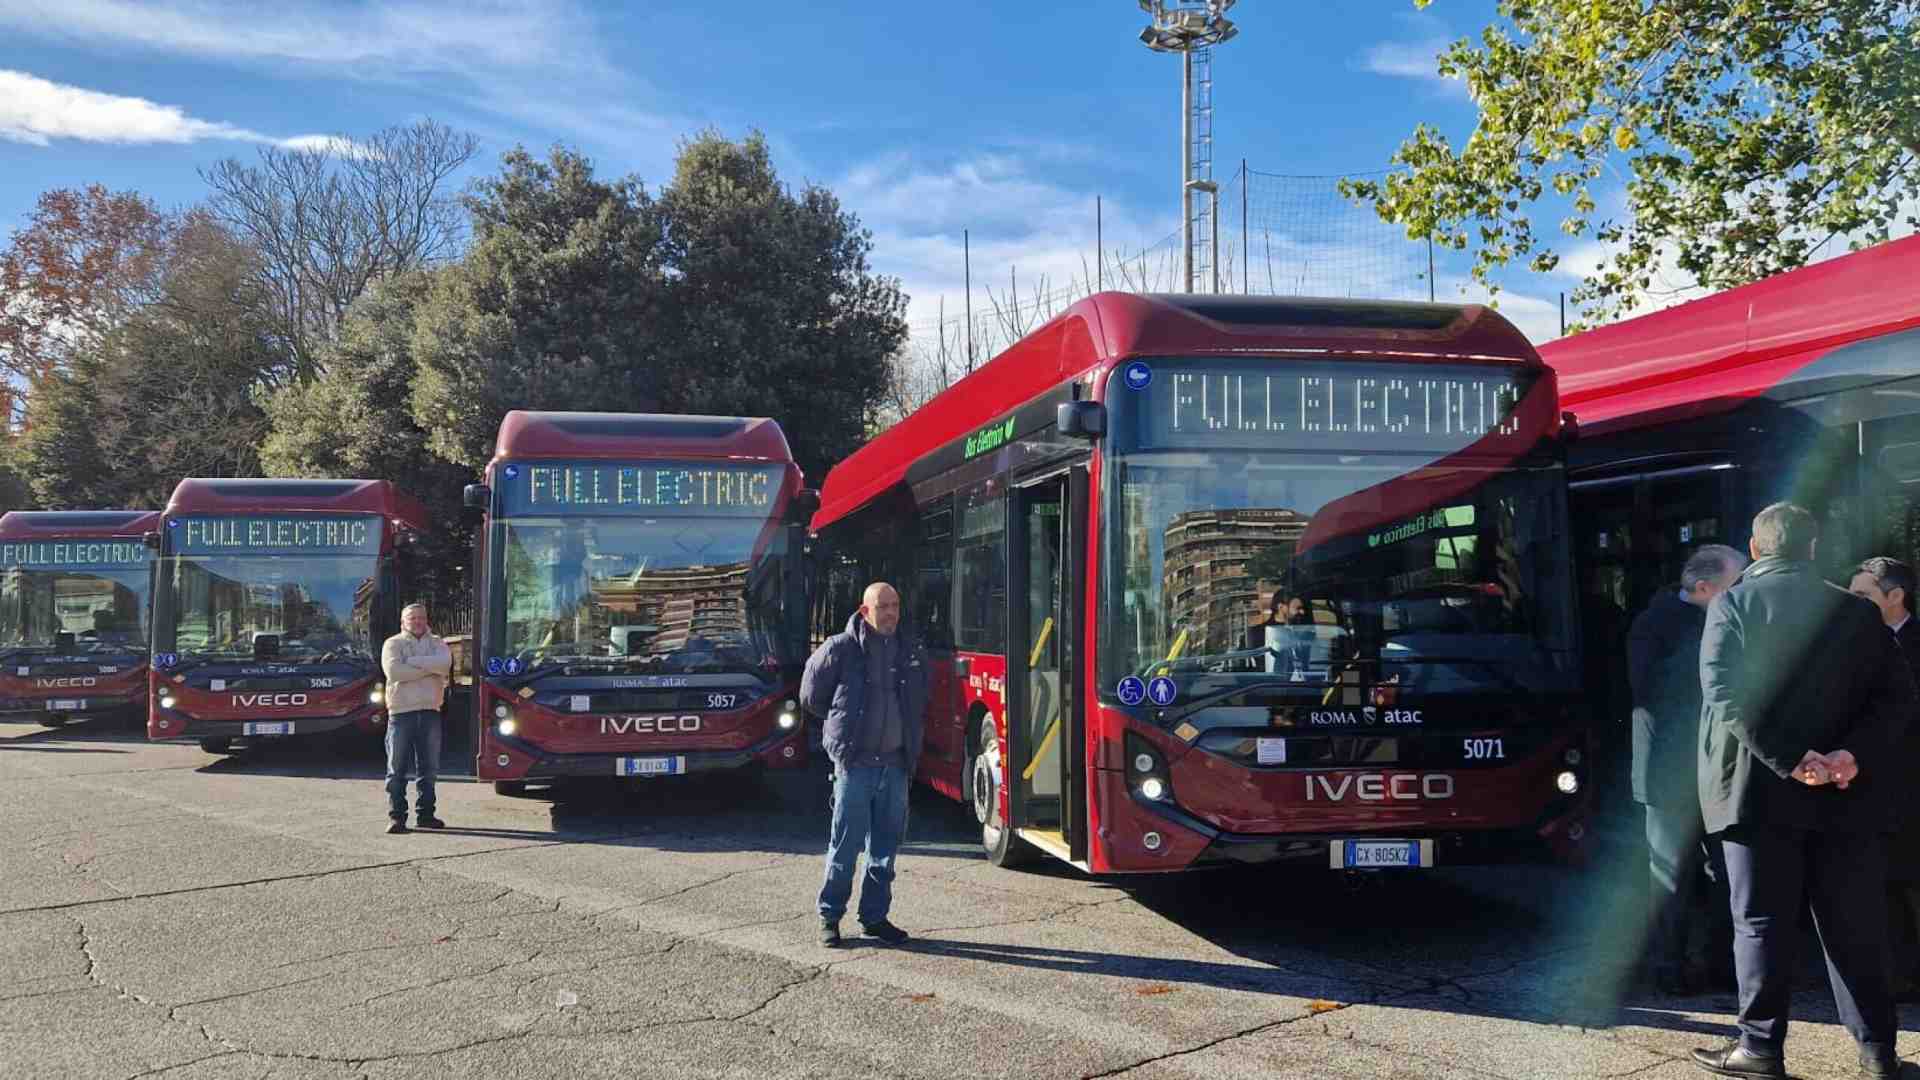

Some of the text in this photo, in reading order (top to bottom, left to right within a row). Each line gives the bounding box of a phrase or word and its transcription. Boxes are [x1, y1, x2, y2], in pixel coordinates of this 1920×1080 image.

[1173, 374, 1518, 434] FULL ELECTRIC
[530, 468, 768, 505] FULL ELECTRIC
[187, 520, 368, 547] FULL ELECTRIC
[3, 544, 143, 564] FULL ELECTRIC
[36, 677, 96, 688] IVECO
[232, 693, 307, 707] IVECO
[707, 694, 736, 708] 5057
[600, 716, 700, 734] IVECO
[1311, 709, 1423, 724] ROMA atac
[1463, 738, 1505, 759] 5071
[1305, 774, 1455, 801] IVECO
